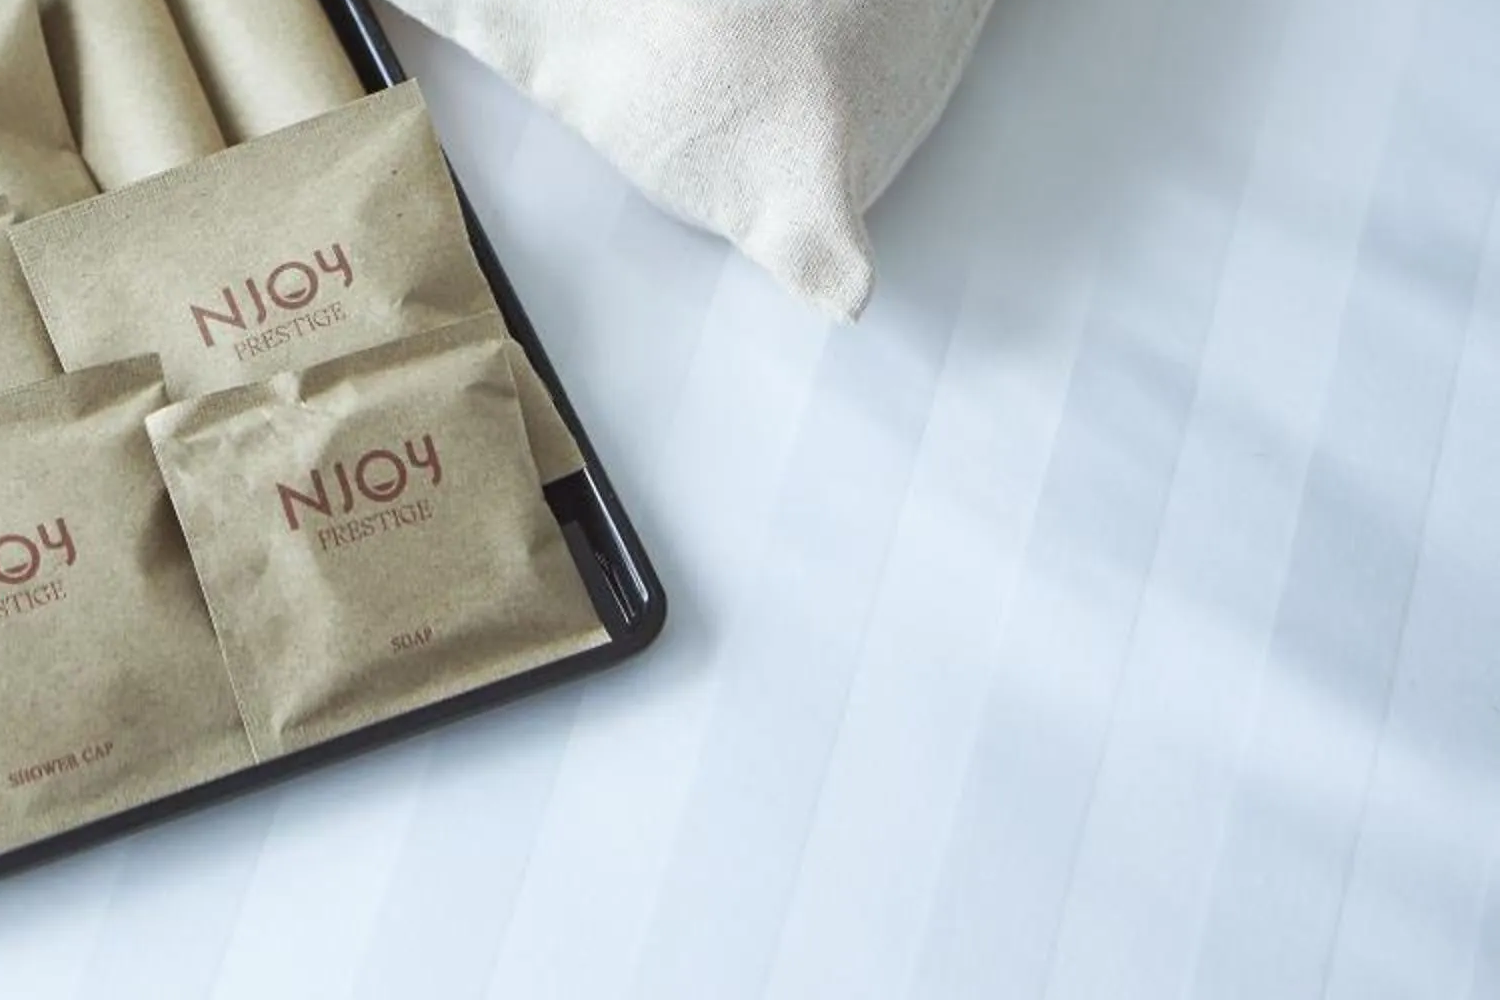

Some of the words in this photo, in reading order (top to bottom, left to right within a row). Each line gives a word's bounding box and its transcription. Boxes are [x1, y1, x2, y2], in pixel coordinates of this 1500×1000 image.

[233, 301, 347, 361] PRESTIGE
[318, 500, 434, 551] PRESTIGE
[391, 627, 433, 652] SOAP
[8, 754, 79, 788] SHOWER
[81, 741, 114, 763] CAP
